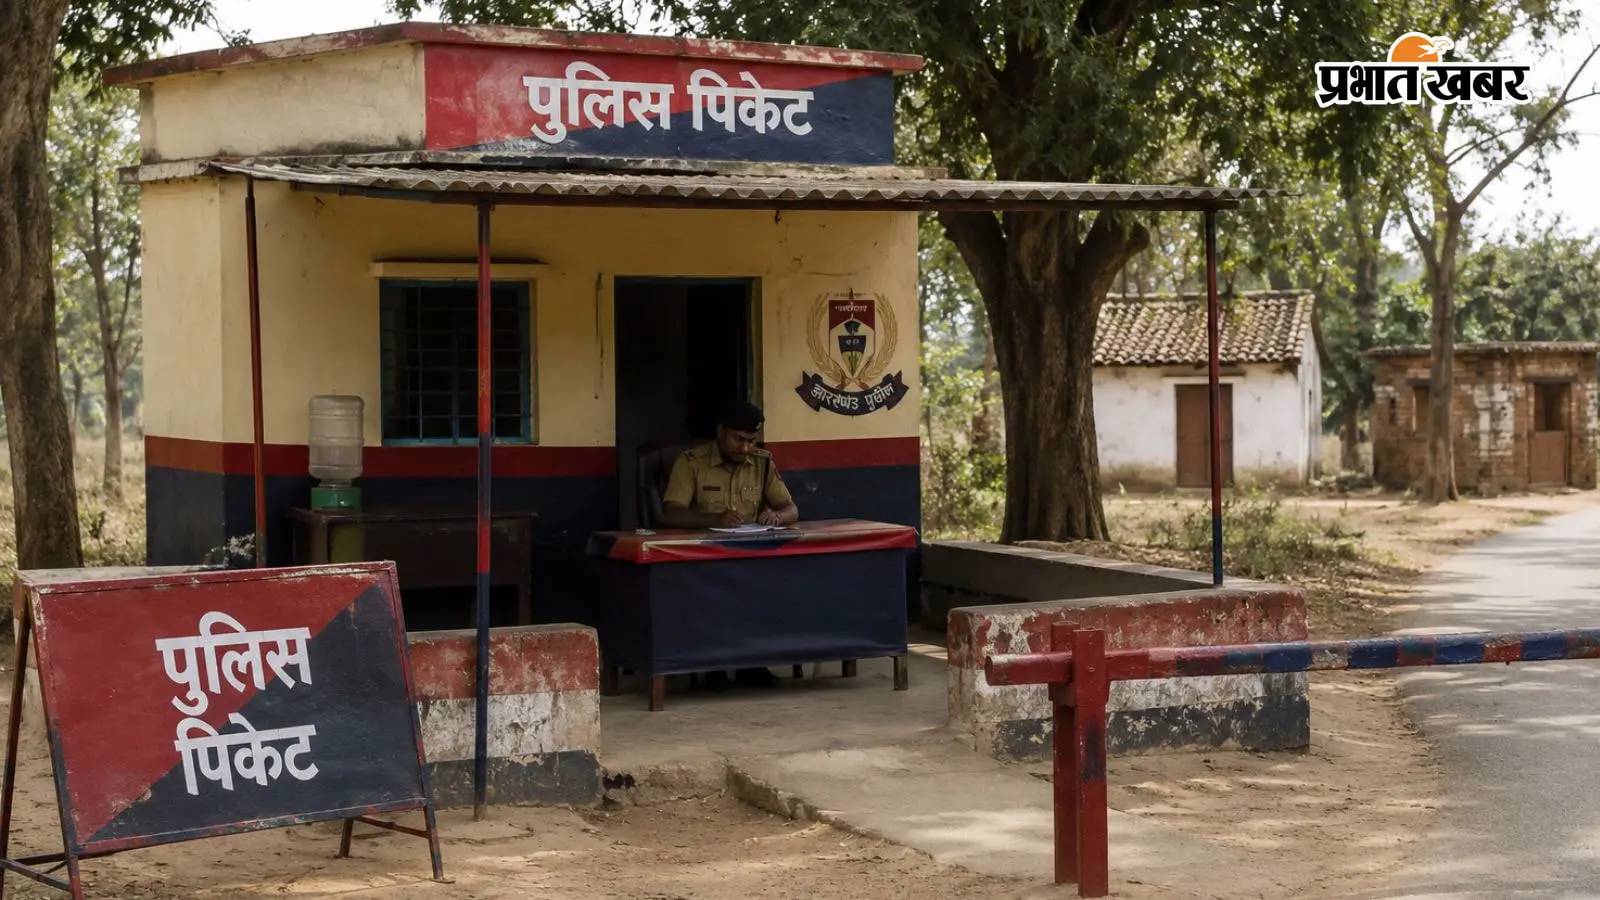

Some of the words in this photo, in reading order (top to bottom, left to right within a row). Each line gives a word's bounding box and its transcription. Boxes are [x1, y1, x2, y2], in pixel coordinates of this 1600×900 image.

[523, 61, 675, 144] पुलिस
[687, 69, 815, 136] पिकेट
[155, 611, 312, 716] पुलिस
[174, 712, 319, 795] पिकेट
